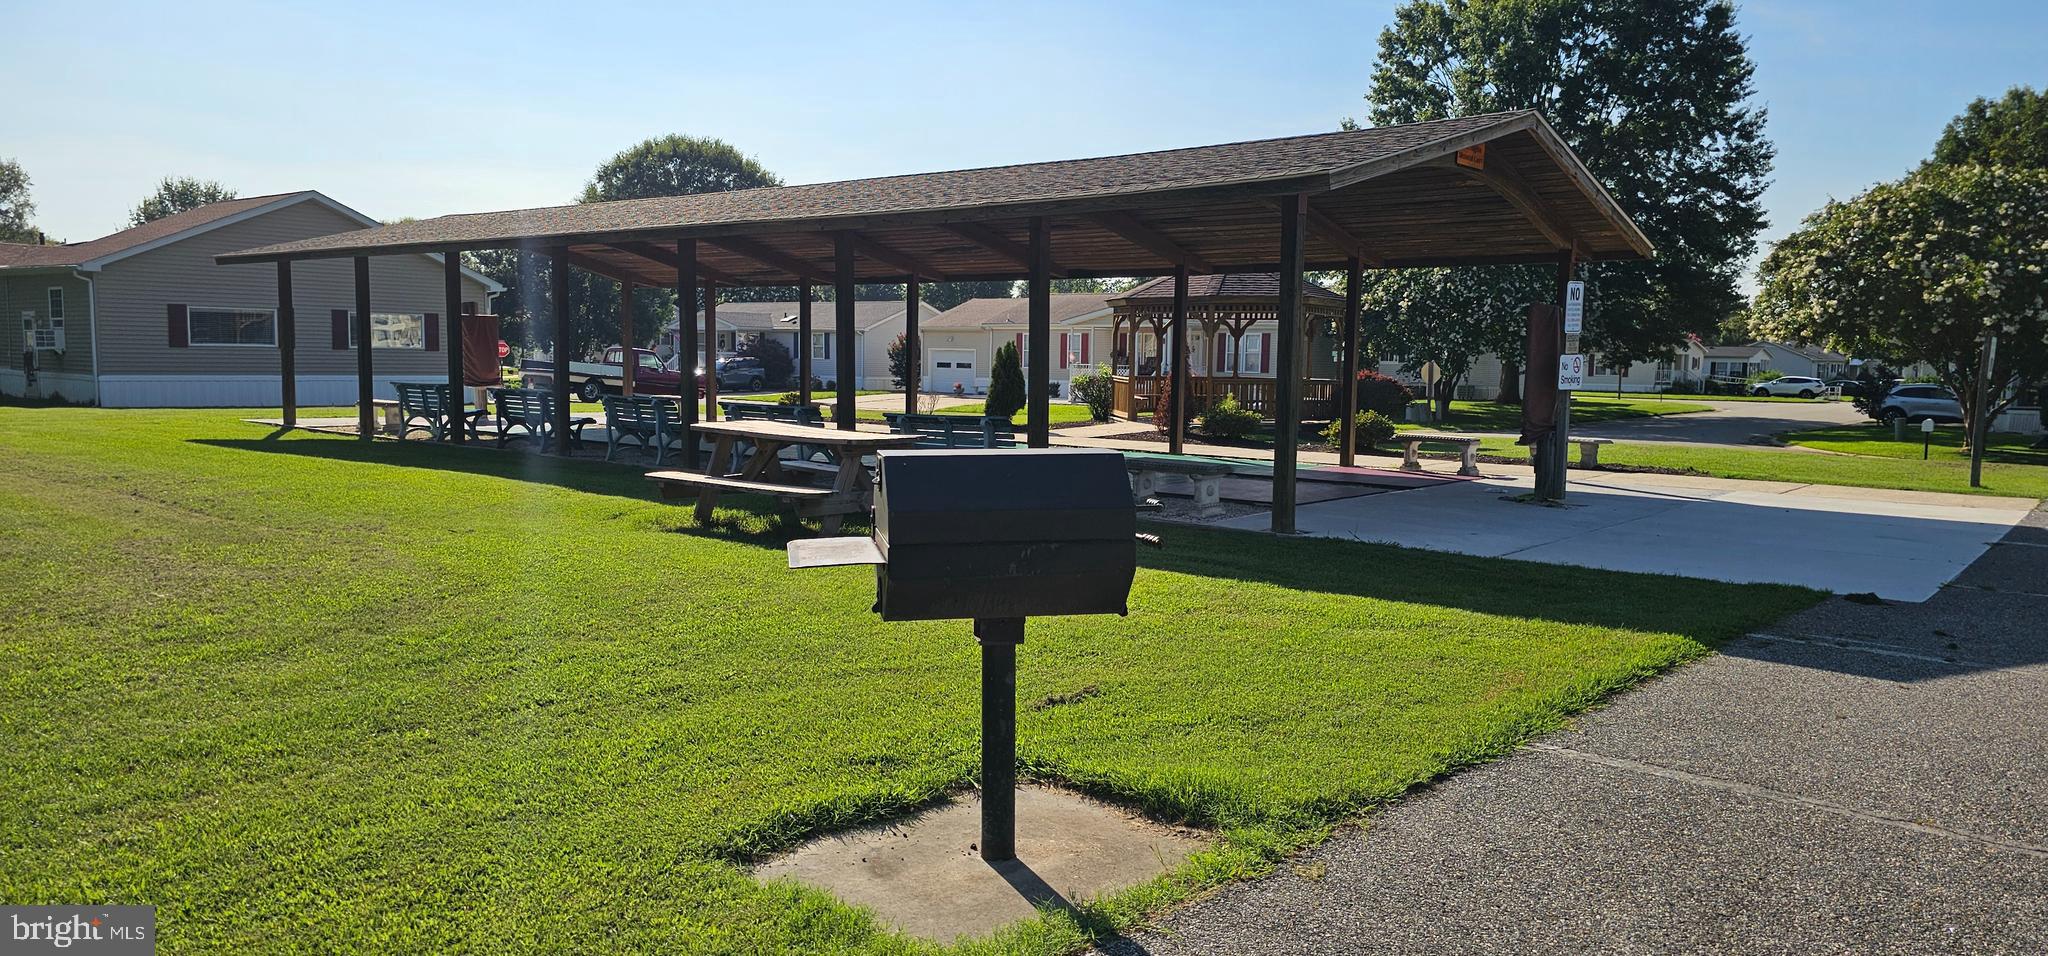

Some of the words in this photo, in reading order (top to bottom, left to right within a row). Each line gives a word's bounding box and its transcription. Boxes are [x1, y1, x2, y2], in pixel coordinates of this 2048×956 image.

[1570, 287, 1580, 301] NO
[1561, 362, 1568, 371] No
[1560, 375, 1581, 386] Smoking
